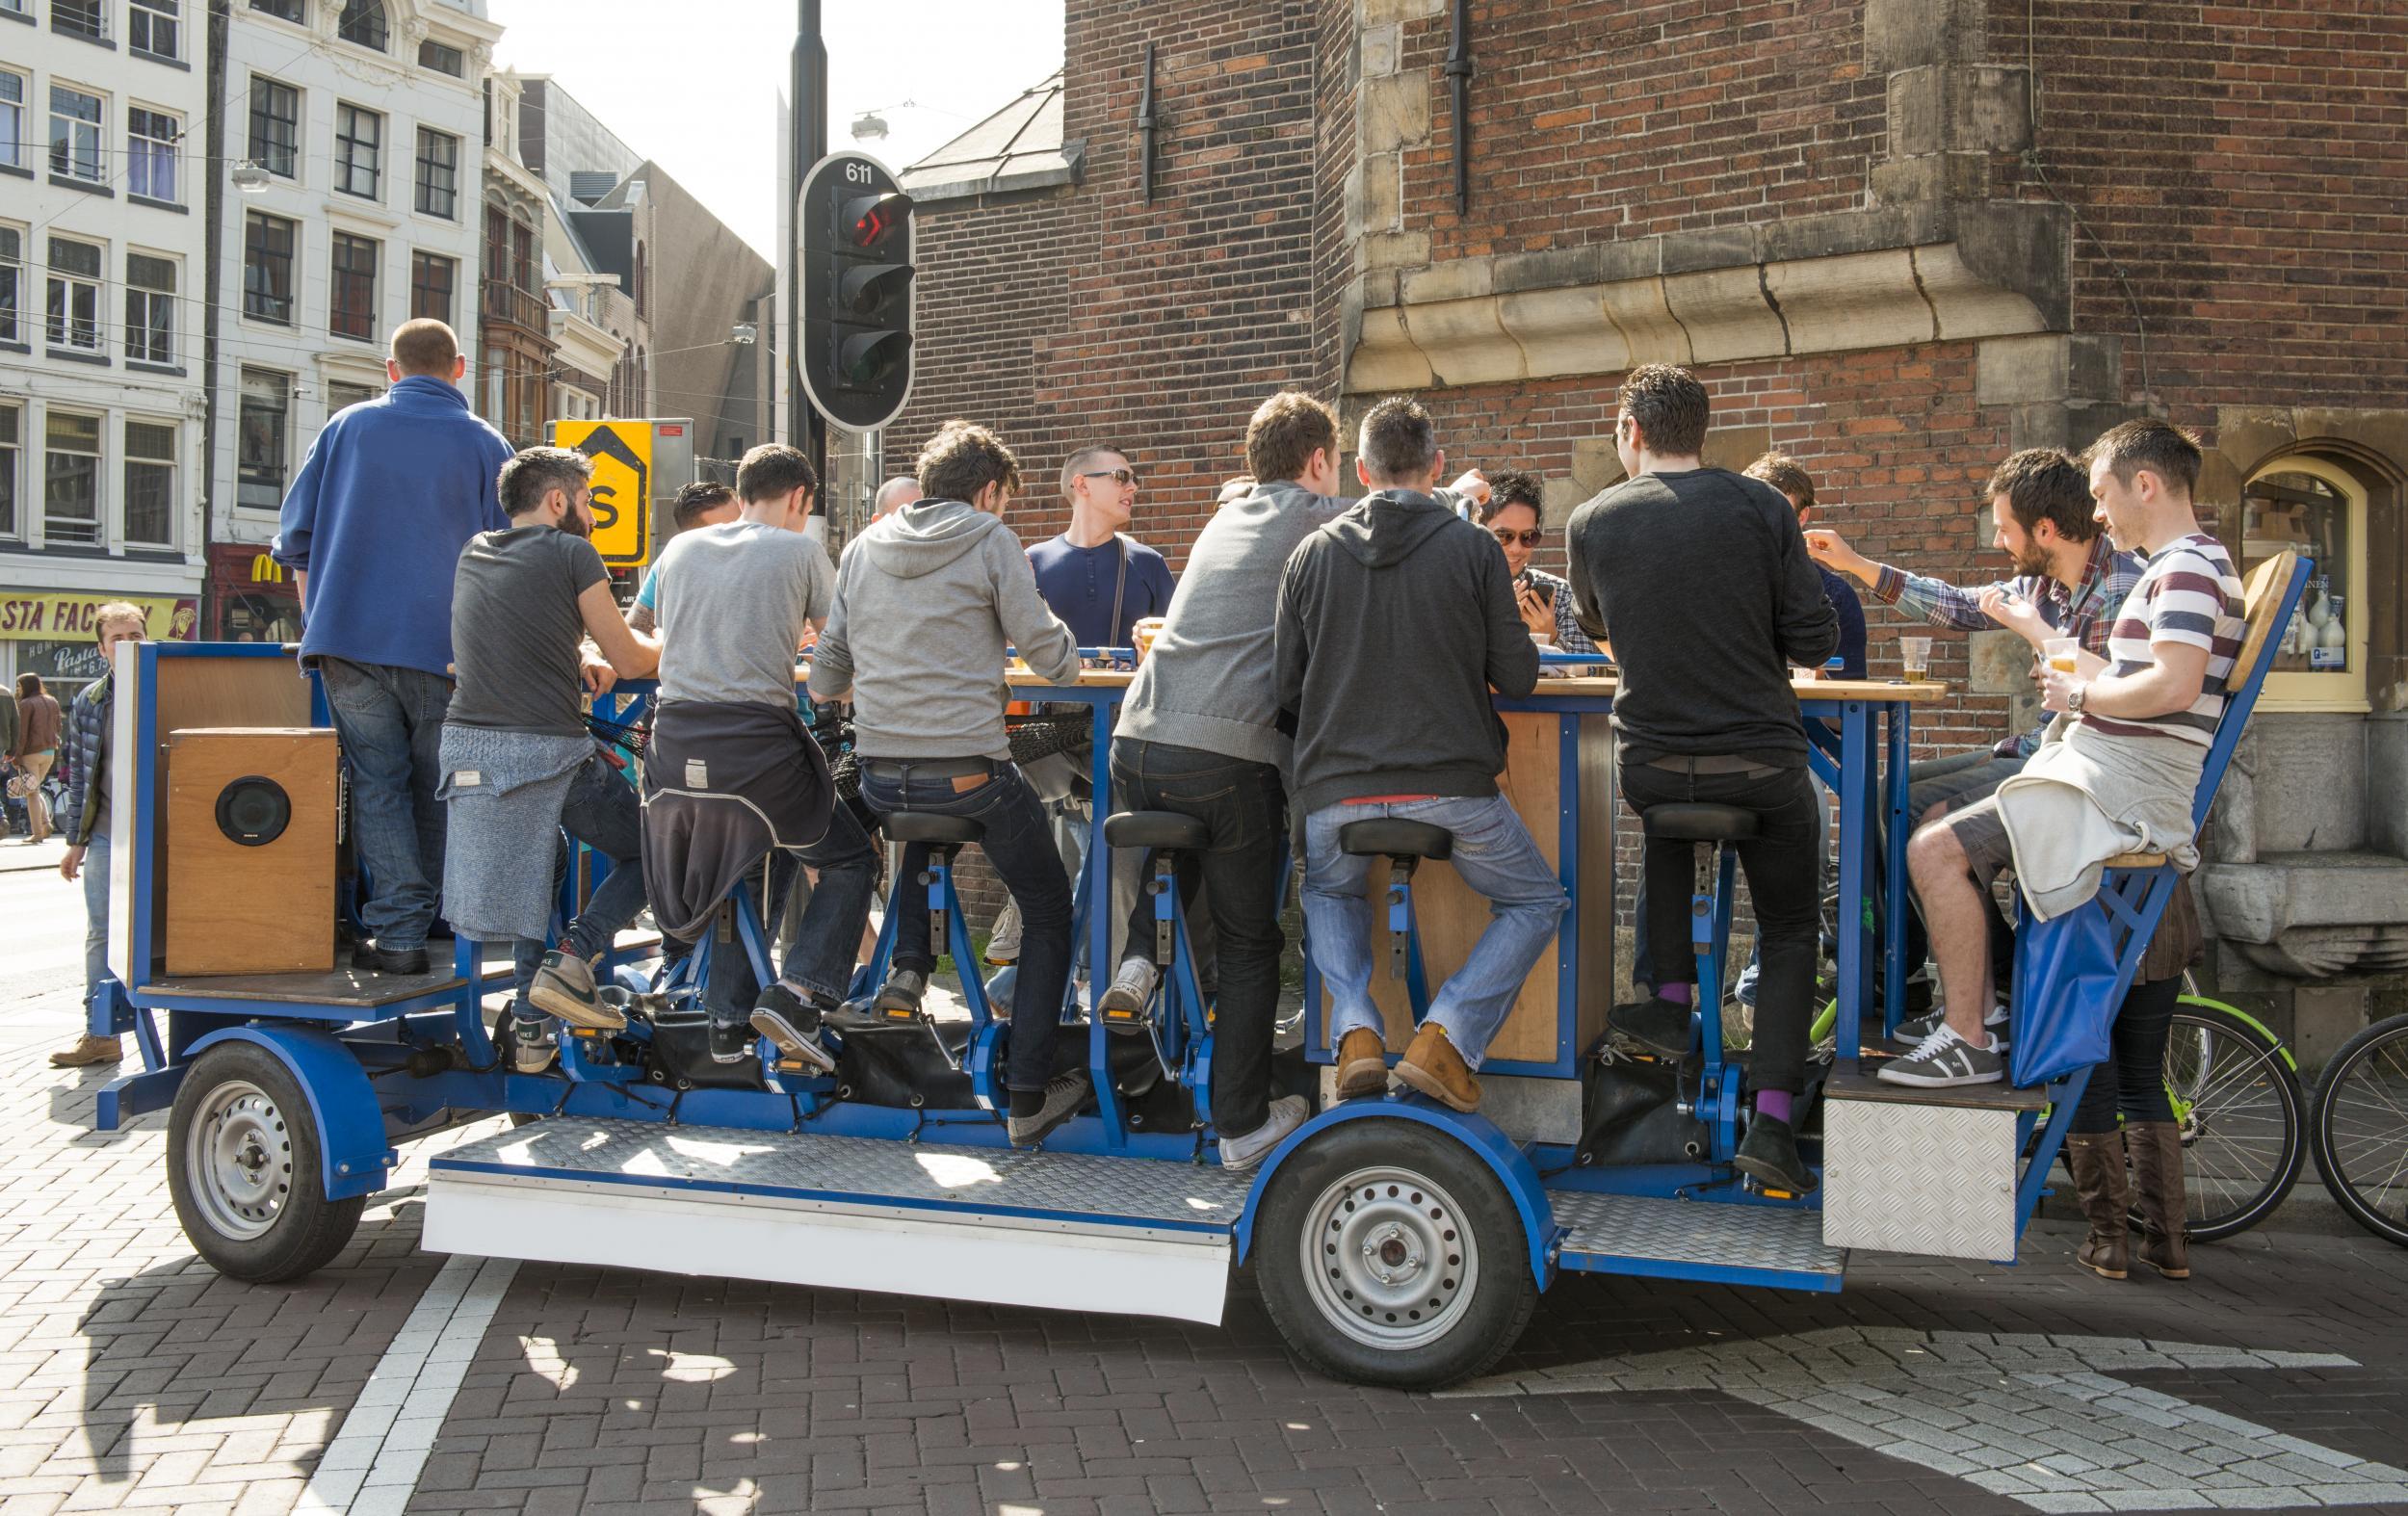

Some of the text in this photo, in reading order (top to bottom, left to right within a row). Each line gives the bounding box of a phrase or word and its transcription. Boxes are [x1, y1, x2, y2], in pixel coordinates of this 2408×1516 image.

[846, 162, 872, 185] 611
[589, 484, 619, 530] S
[0, 600, 43, 631] STA
[54, 646, 99, 672] Pasta
